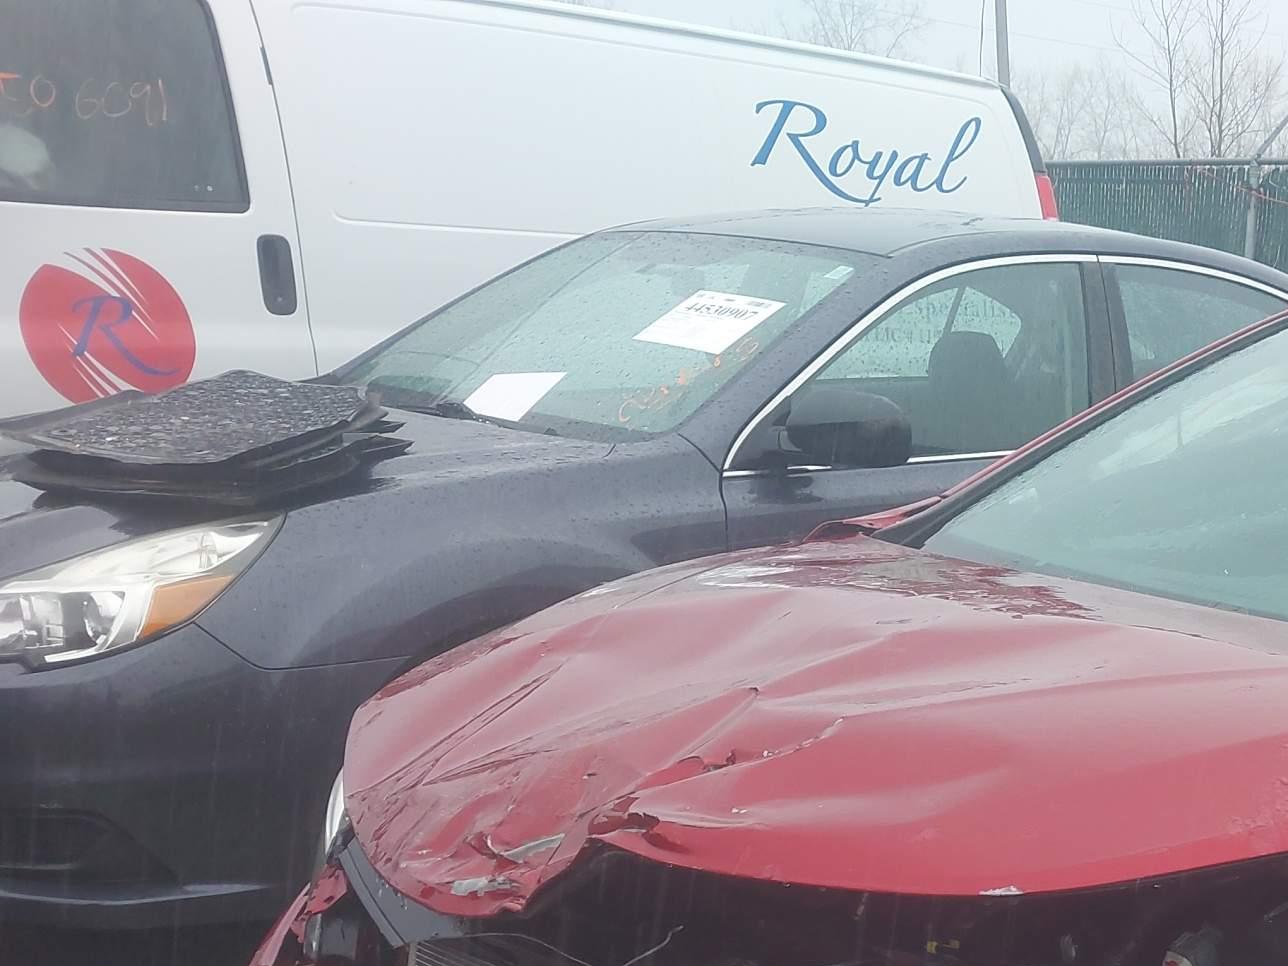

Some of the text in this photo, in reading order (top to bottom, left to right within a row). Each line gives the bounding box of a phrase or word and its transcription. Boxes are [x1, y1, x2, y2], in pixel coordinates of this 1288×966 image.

[750, 99, 982, 207] Royal
[71, 295, 182, 376] R
[684, 302, 760, 321] 44530907
